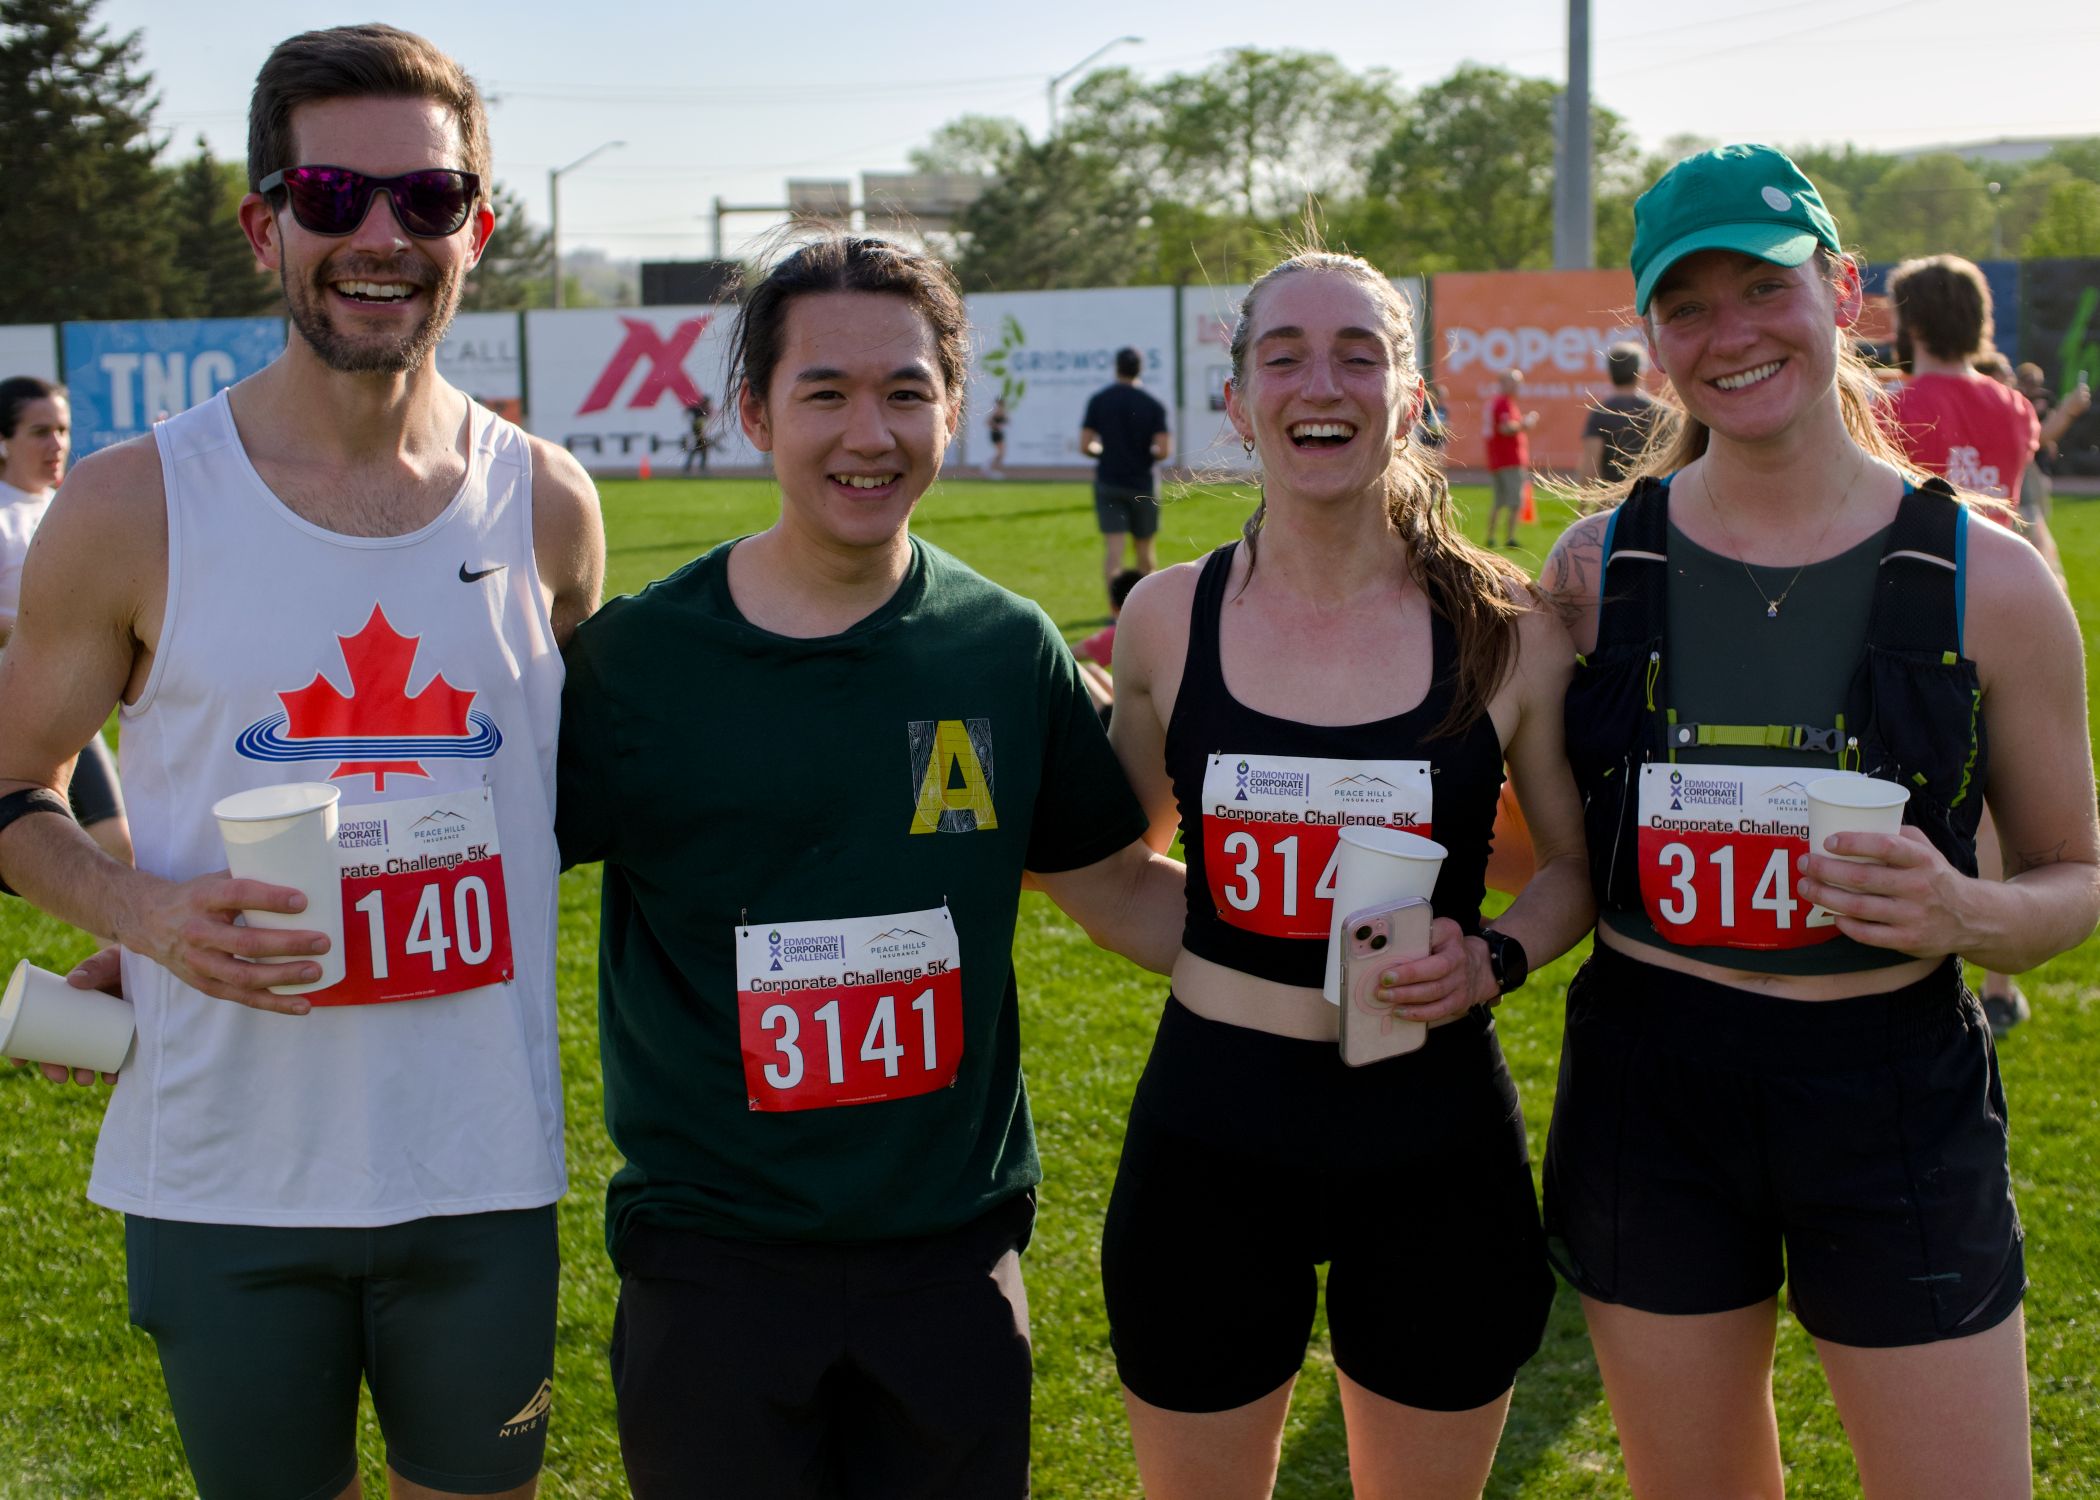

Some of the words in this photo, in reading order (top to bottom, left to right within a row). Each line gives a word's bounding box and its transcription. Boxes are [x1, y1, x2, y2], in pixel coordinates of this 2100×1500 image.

[101, 351, 236, 429] TNC
[1250, 770, 1304, 780] EDMONTON
[1249, 778, 1304, 789] CORPORATE
[1684, 779, 1737, 789] EDMONTON
[1249, 786, 1304, 797] CHALLENGE
[1334, 789, 1364, 797] PEACE
[1683, 787, 1737, 798] CORPORATE
[1683, 795, 1737, 806] CHALLENGE
[1768, 797, 1798, 806] PEACE
[1215, 805, 1299, 826] Corporate
[1304, 810, 1386, 827] Challenge
[1393, 812, 1419, 827] 5K
[338, 820, 382, 831] MONTON
[414, 829, 442, 839] PEACE
[444, 824, 466, 834] HILLS
[1651, 815, 1734, 833] Corporate
[1739, 819, 1810, 840] Challeng
[338, 829, 382, 840] RPORATE
[423, 834, 460, 844] INSURANCE
[338, 837, 383, 848] ALLENGE
[386, 851, 463, 875] Challenge
[468, 844, 490, 862] 5K
[1658, 842, 1835, 929] 314
[355, 875, 493, 980] 140
[783, 935, 838, 947] EDMONTON
[783, 943, 839, 955] CORPORATE
[870, 944, 901, 954] PEACE
[903, 941, 927, 950] HILLS
[784, 951, 840, 963] CHALLENGE
[879, 950, 920, 959] INSURANCE
[750, 974, 837, 995] Corporate
[843, 963, 923, 986] Challenge
[927, 959, 949, 976] 5K
[760, 988, 937, 1090] 3141
[499, 1419, 537, 1438] NIKE
